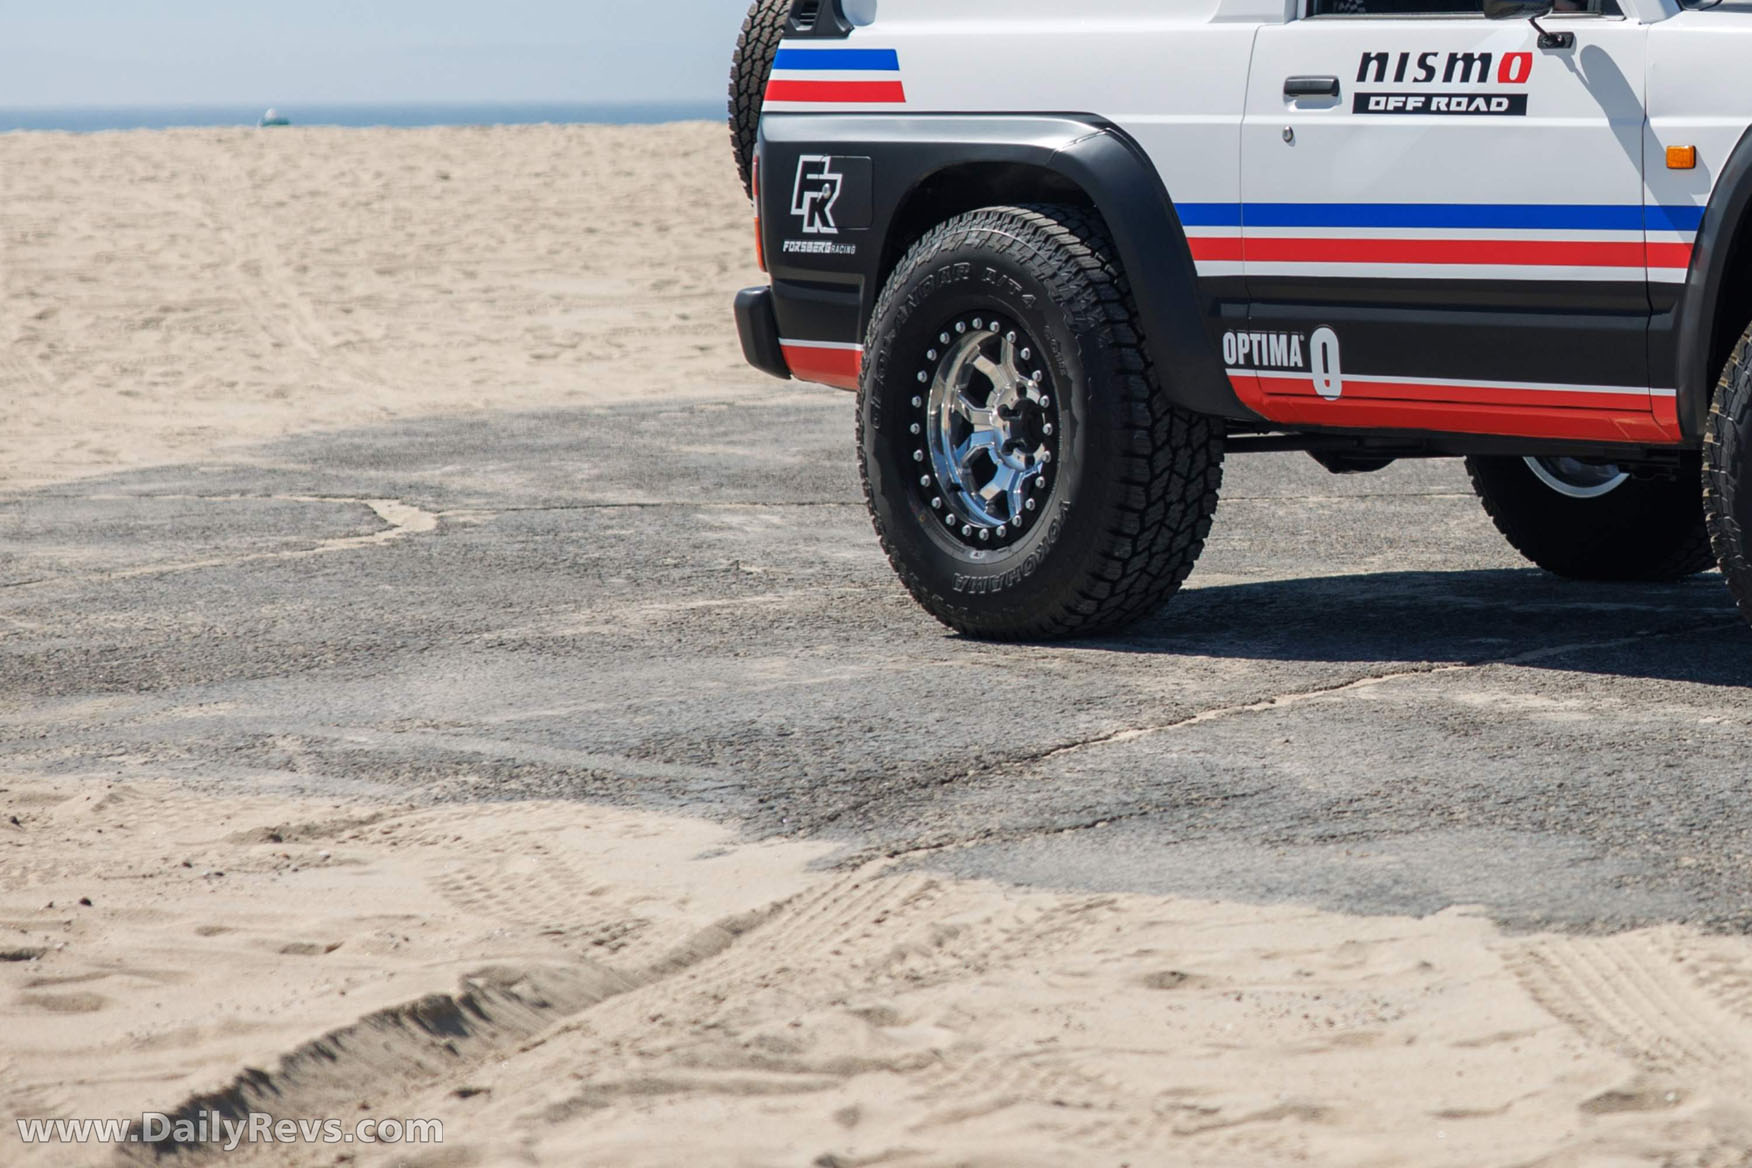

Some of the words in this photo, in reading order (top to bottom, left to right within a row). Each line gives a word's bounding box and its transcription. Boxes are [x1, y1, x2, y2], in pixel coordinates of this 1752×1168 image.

[1367, 95, 1426, 112] OFF
[1429, 96, 1509, 113] ROAD
[951, 499, 1073, 595] YOKOHAMA
